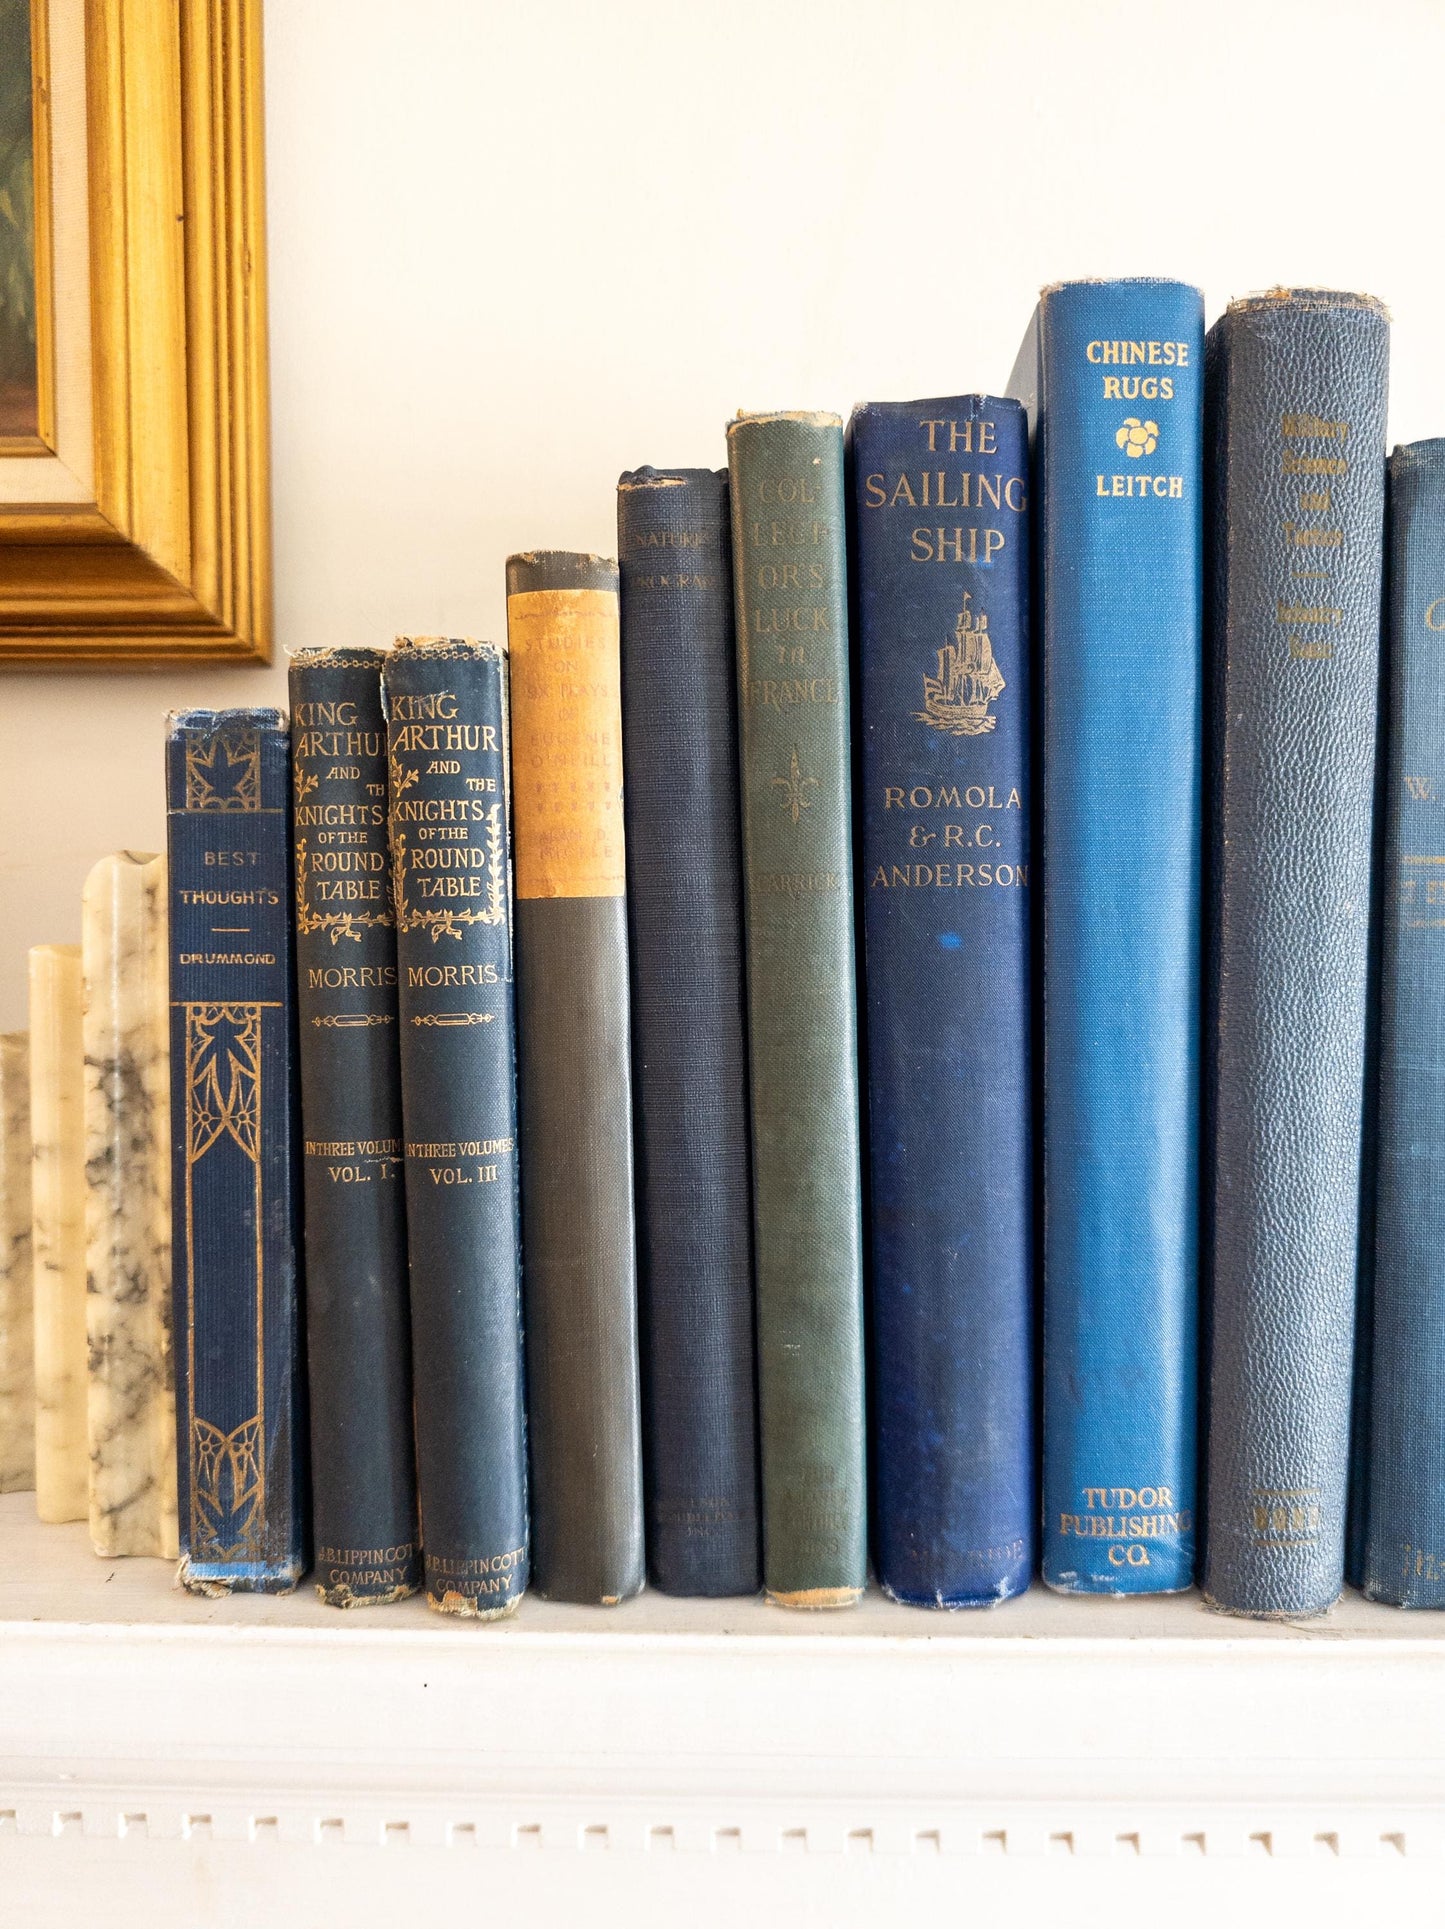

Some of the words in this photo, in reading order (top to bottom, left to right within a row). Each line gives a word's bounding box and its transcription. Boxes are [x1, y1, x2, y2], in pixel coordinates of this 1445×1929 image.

[1086, 340, 1189, 367] CHINESE
[1103, 376, 1175, 400] RUGS
[919, 420, 998, 454] THE
[865, 471, 1028, 512] SAILING
[1096, 475, 1183, 498] LEITCH
[911, 527, 1005, 563] SHIP
[754, 606, 830, 633] LUCK
[295, 702, 358, 727] KING
[391, 694, 459, 721] KING
[391, 725, 499, 752] ARTHUR
[326, 766, 360, 779] AND
[426, 761, 461, 774] AND
[366, 783, 385, 796] TH
[466, 778, 496, 792] THE
[884, 786, 1022, 809] ROMOLA
[295, 804, 384, 826] KNIGHTS
[393, 800, 484, 821] KNIGHTS
[909, 825, 936, 848] &
[945, 825, 1001, 848] R.C.
[204, 851, 258, 866] BEST
[311, 852, 385, 872] ROUND
[411, 849, 485, 870] ROUND
[871, 863, 1029, 889] ANDERSON
[179, 889, 279, 905] THOUGHTS
[317, 880, 381, 900] TABLE
[417, 877, 482, 897] TABLE
[180, 953, 276, 966] DRUMMOND
[309, 967, 398, 989] MORRIS
[408, 965, 498, 987] MORRIS
[316, 1141, 355, 1156] THREE
[459, 1138, 514, 1156] VOLUMES
[328, 1166, 371, 1182] VOL.
[429, 1168, 472, 1185] VOL.
[478, 1164, 498, 1183] III
[1082, 1486, 1173, 1509] TUDOR
[1060, 1511, 1192, 1538] PUBLISHING
[330, 1566, 408, 1585] COMPANY
[436, 1574, 513, 1595] COMPANY
